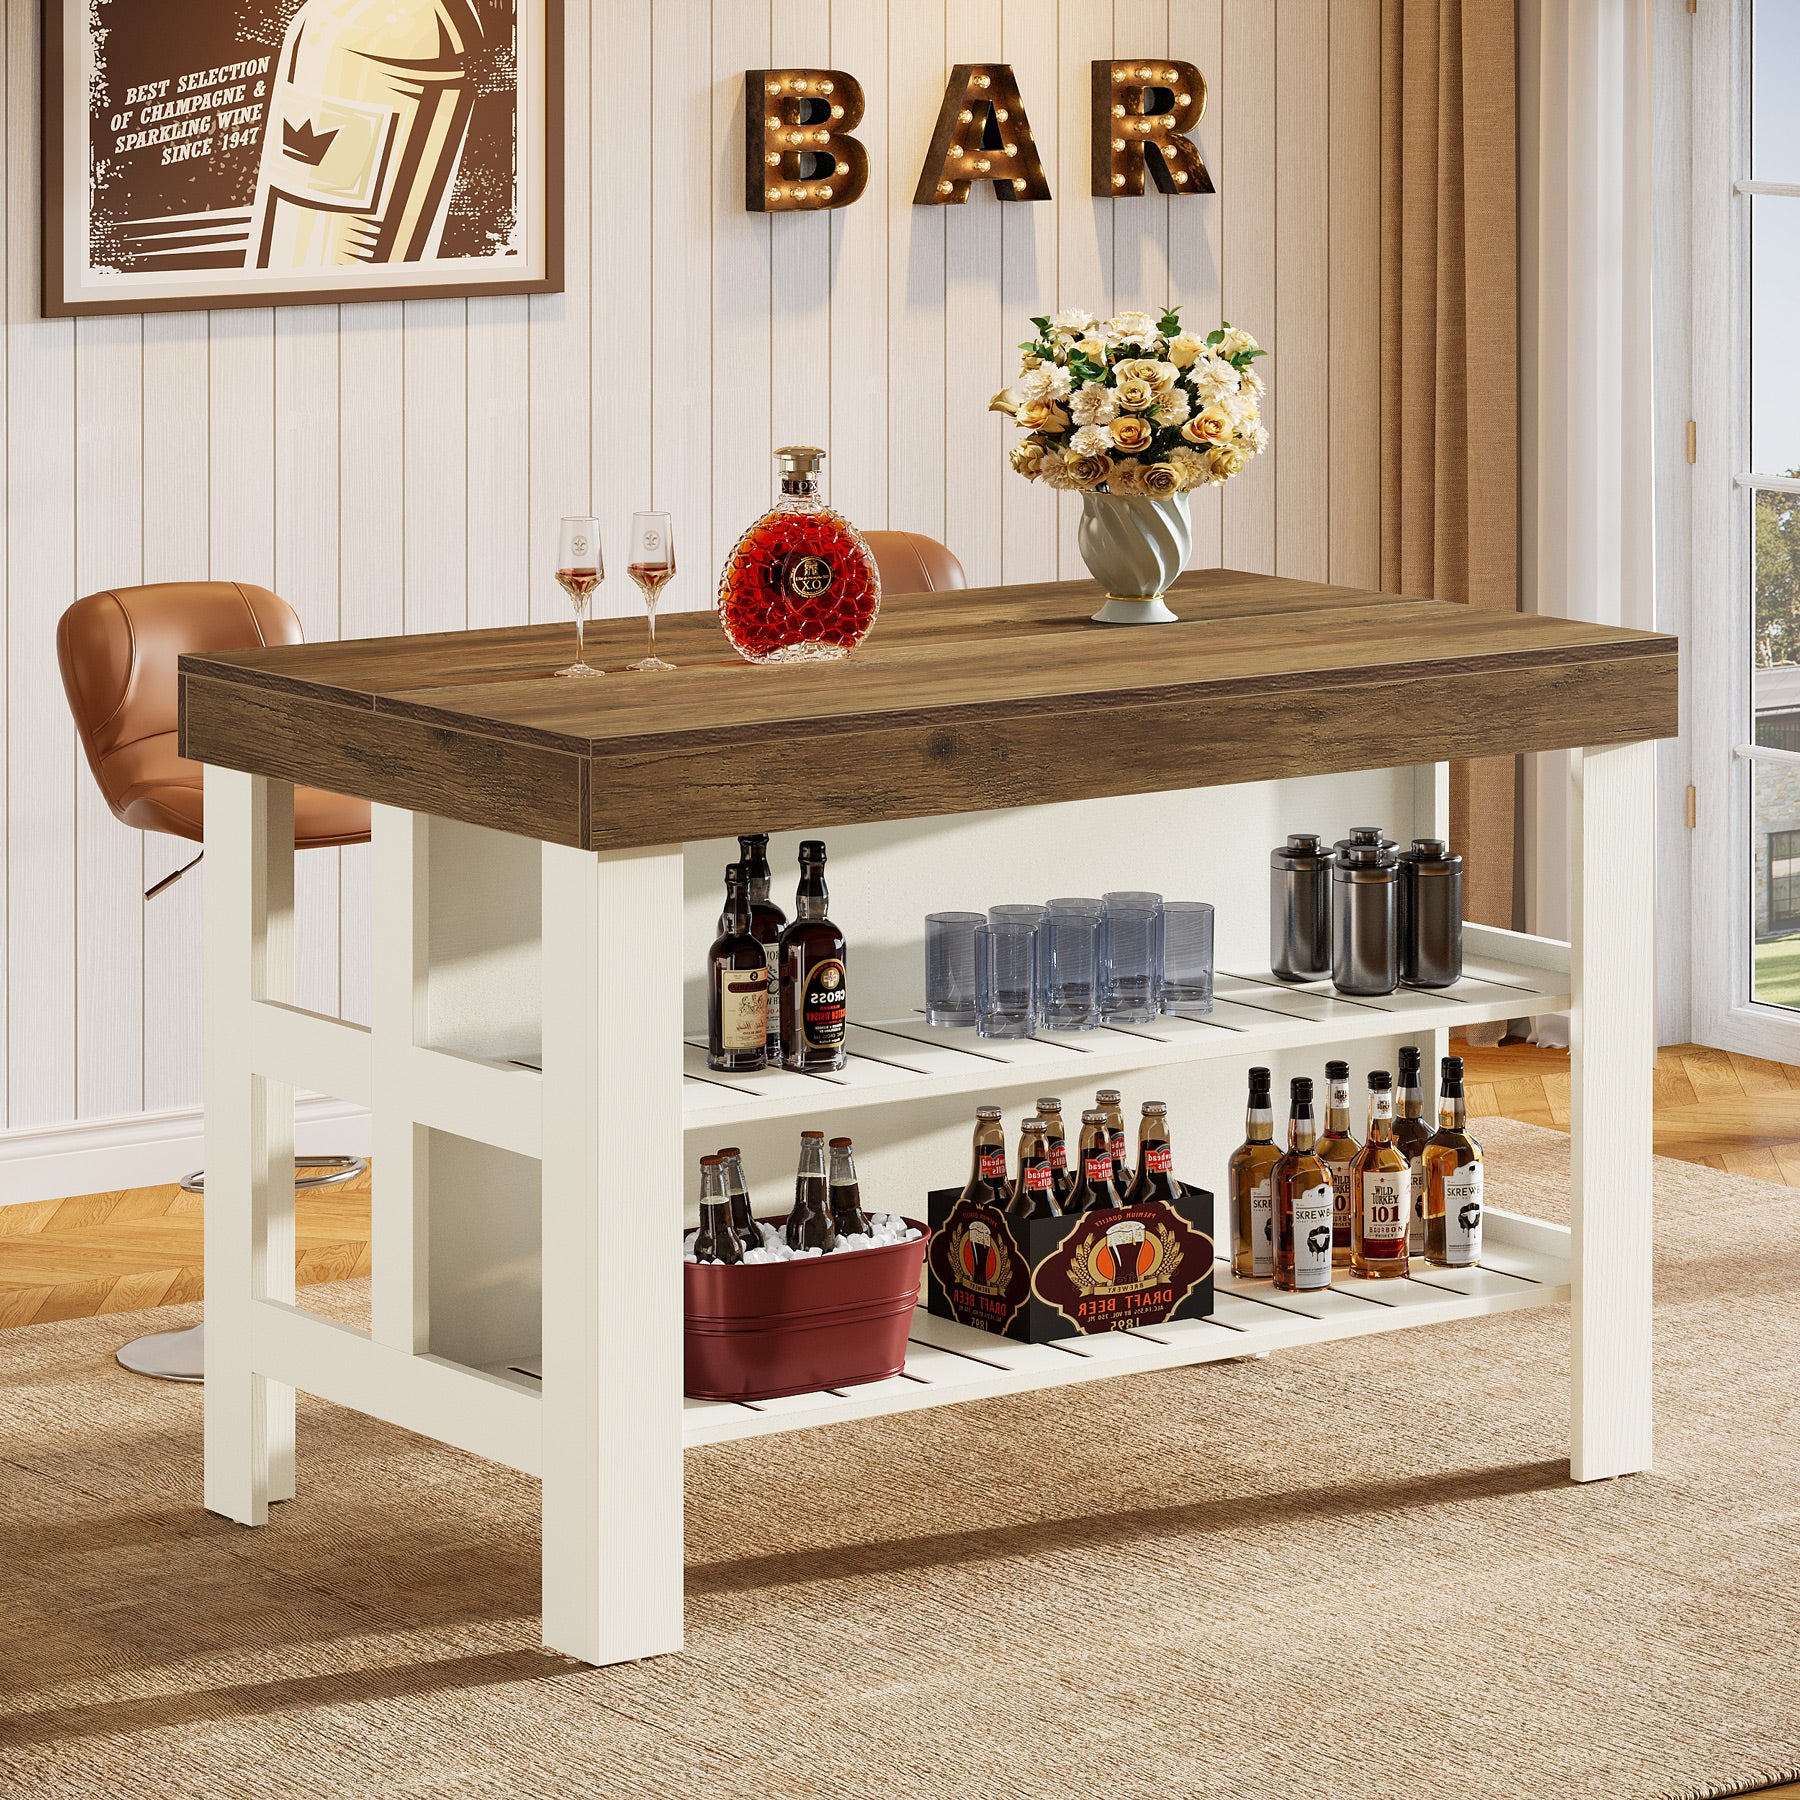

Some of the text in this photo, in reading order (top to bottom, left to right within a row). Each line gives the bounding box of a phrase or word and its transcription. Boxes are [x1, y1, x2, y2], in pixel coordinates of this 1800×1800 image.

[125, 56, 271, 106] BEST SELECTION
[110, 80, 266, 131] OF CHAMPAGNE &
[114, 103, 264, 154] SPARKLING WINE
[161, 126, 260, 166] SINCE 1947
[745, 59, 1216, 213] BAR
[1371, 1193, 1399, 1205] TURKEY
[1372, 1205, 1400, 1222] 101
[1375, 1186, 1393, 1196] WILD
